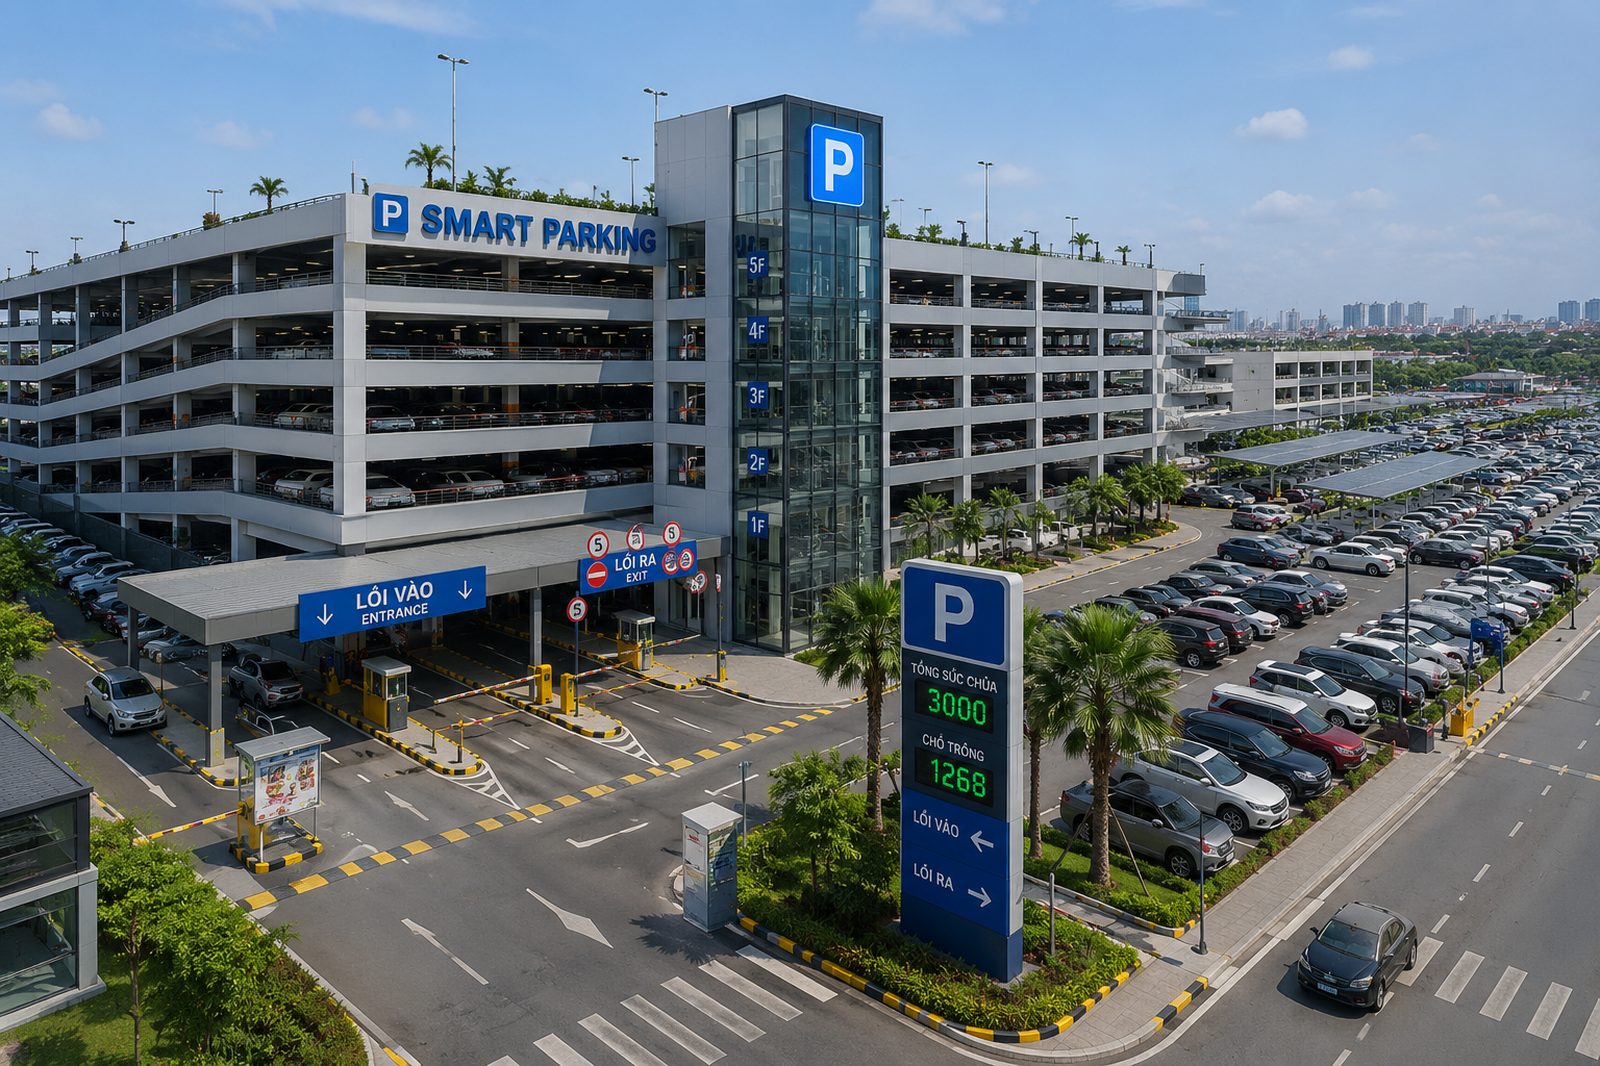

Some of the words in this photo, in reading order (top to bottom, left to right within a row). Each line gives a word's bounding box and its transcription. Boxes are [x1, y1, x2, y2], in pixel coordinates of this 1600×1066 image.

[825, 138, 854, 192] P
[382, 199, 402, 227] P
[421, 203, 533, 246] SMART
[543, 217, 656, 253] PARKING
[750, 256, 765, 274] 5F
[749, 322, 765, 340] 4F
[750, 387, 765, 405] 3F
[750, 454, 765, 471] 2F
[752, 516, 765, 533] 1F
[595, 537, 603, 553] 5
[615, 552, 636, 572] LỐI
[640, 552, 657, 568] RA
[626, 570, 648, 583] EXIT
[356, 585, 388, 610] LỐI
[394, 581, 434, 603] VÀO
[361, 603, 428, 625] ENTRANCE
[934, 582, 974, 643] P
[928, 688, 987, 726] 3000
[931, 759, 986, 798] 1268
[936, 872, 954, 892] RA
